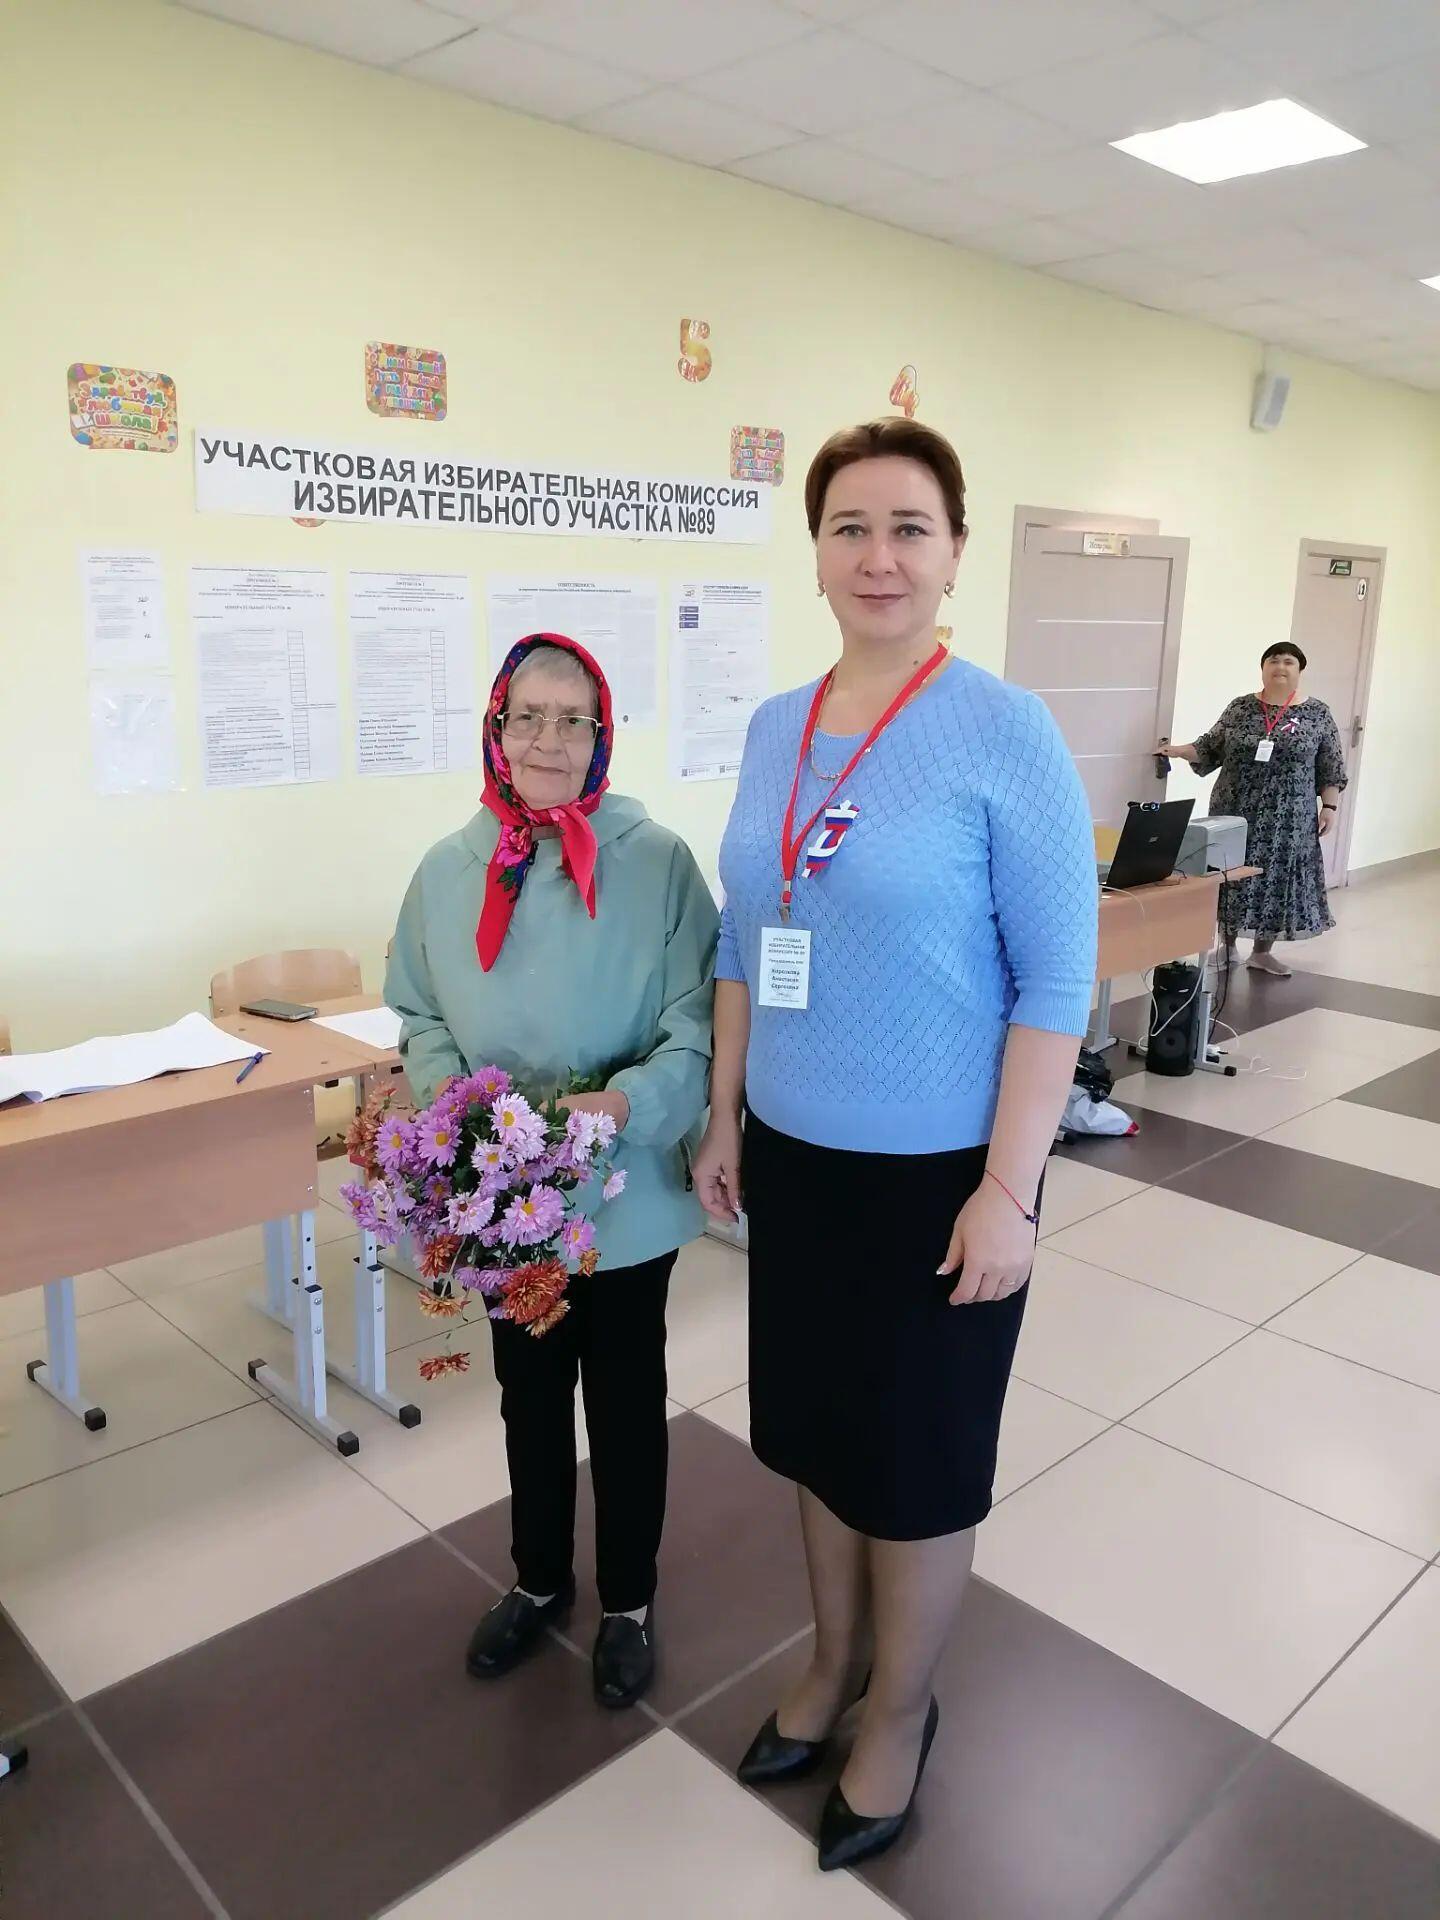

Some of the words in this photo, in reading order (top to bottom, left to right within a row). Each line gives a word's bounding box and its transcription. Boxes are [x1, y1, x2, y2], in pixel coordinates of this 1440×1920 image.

[200, 438, 416, 483] УЧАСТКОВАЯ
[424, 461, 640, 501] ИЗБИРАТЕЛЬНАЯ
[647, 481, 759, 509] КОМИССИЯ
[293, 480, 560, 527] ИЗБИРАТЕЛЬНОГО
[567, 499, 673, 532] УЧАСТКА
[678, 505, 716, 535] №89
